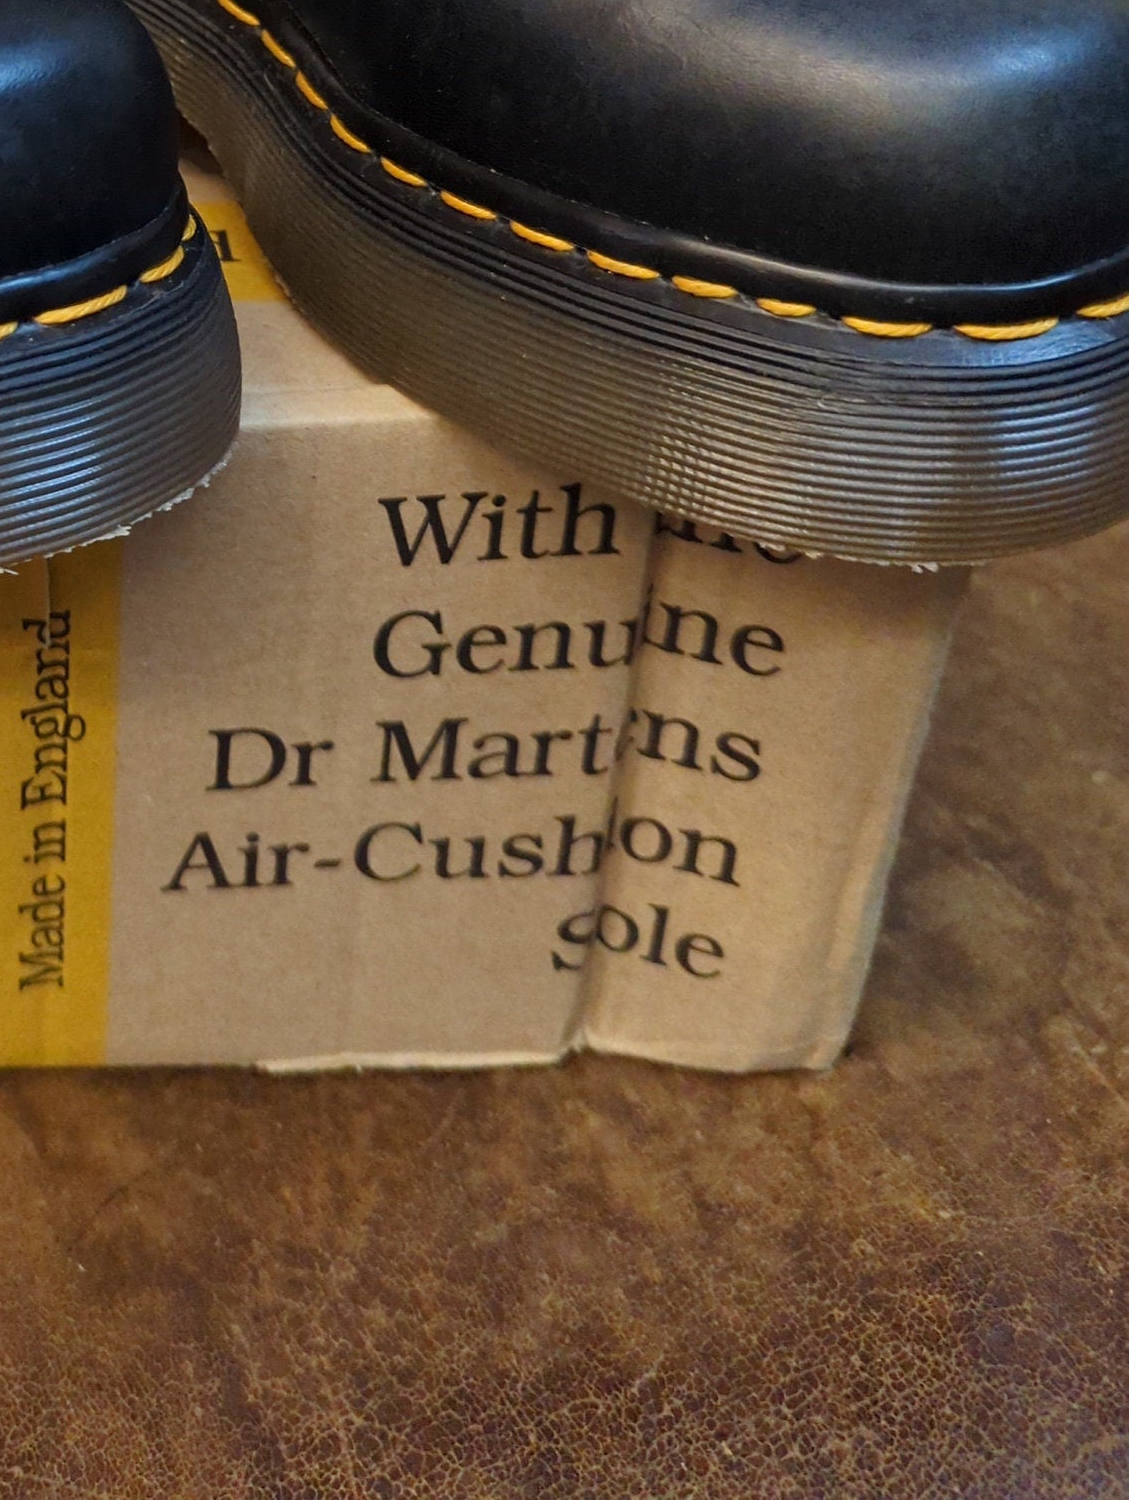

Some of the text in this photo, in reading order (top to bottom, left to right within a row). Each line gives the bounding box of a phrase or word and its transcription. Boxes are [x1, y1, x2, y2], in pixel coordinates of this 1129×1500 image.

[378, 482, 620, 569] With
[206, 707, 761, 792] Dr Martns
[18, 609, 87, 993] Made in England
